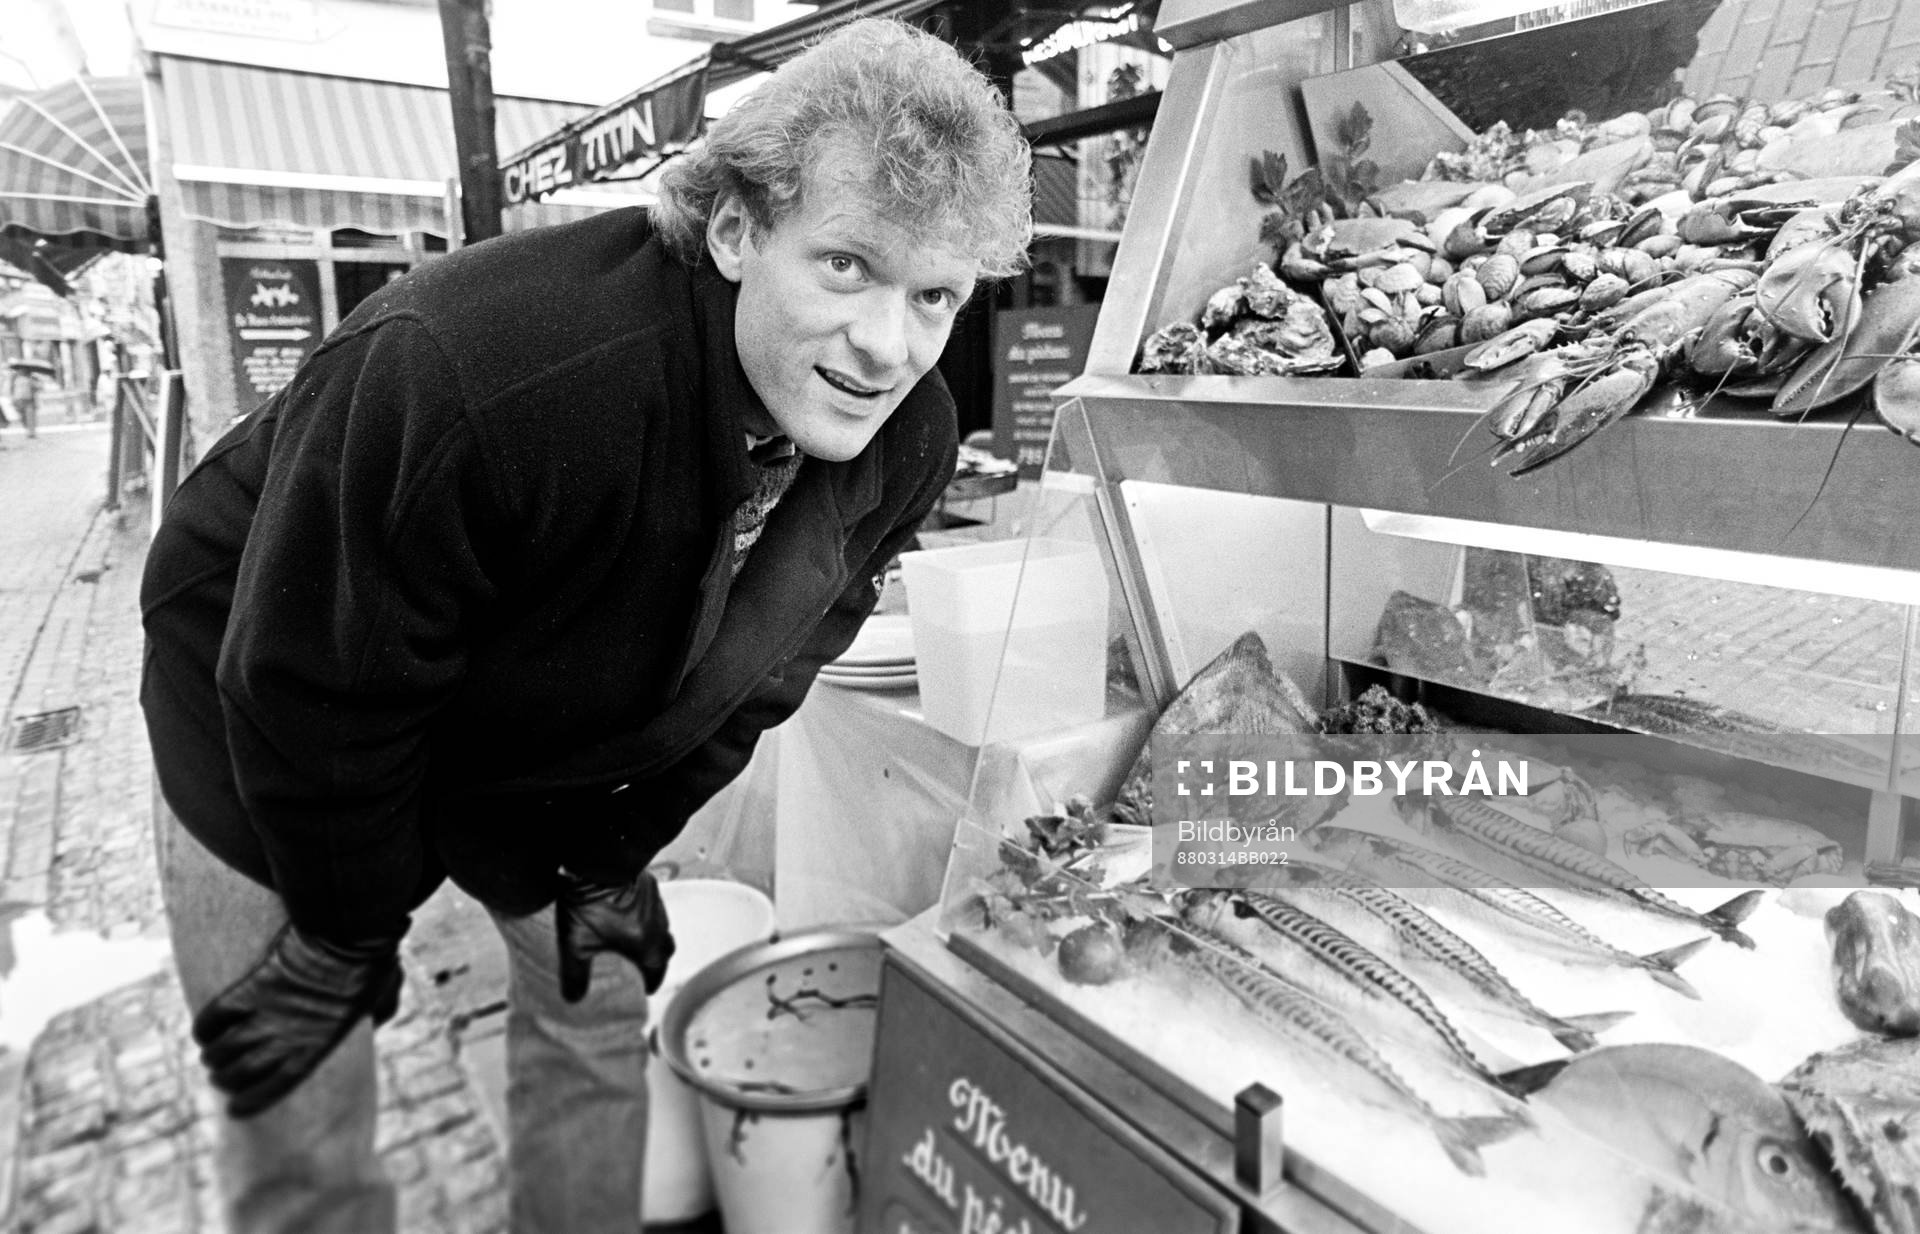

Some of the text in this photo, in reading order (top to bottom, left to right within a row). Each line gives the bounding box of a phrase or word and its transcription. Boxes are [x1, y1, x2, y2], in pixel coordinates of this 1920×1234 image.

[504, 99, 656, 203] CHEZ TITIN
[902, 1126, 959, 1208] du
[949, 1077, 1087, 1232] Menu
